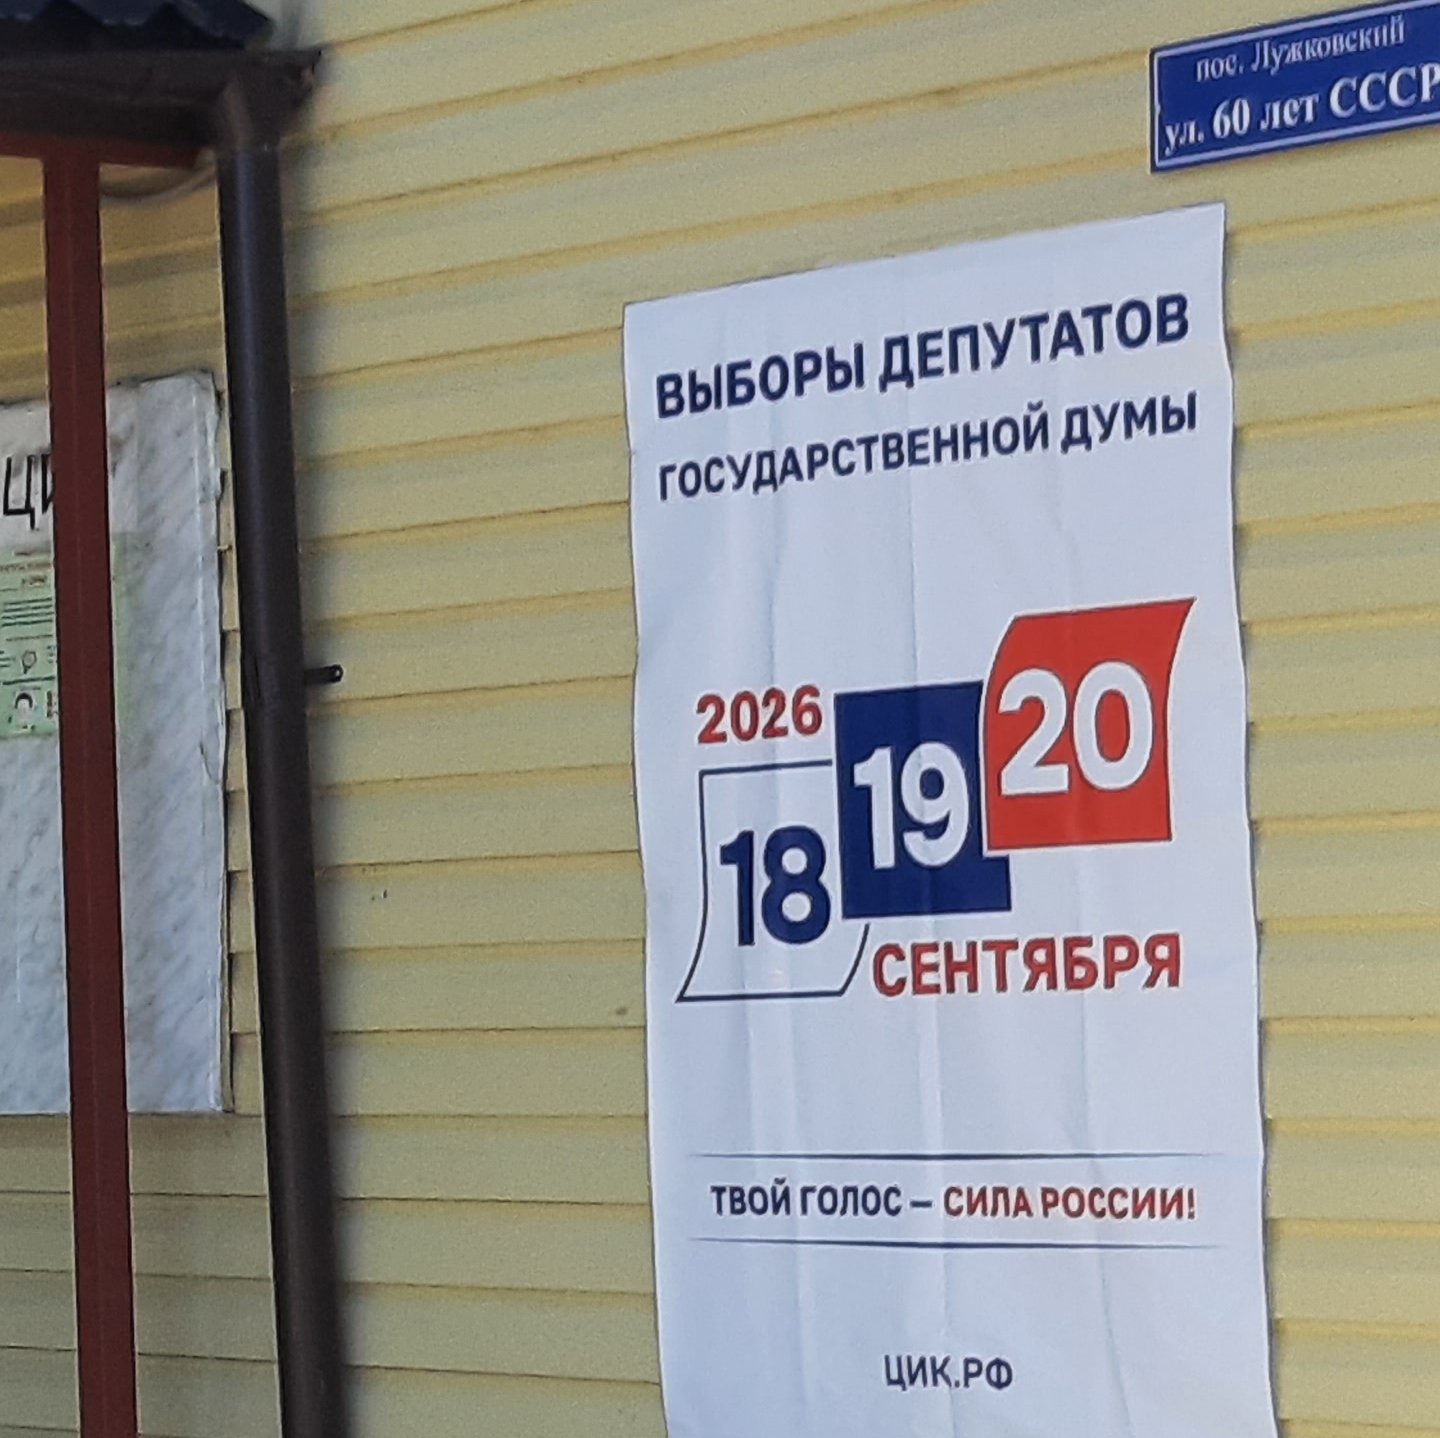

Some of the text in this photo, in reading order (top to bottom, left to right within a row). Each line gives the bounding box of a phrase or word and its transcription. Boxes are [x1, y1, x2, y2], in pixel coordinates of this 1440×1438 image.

[1196, 12, 1406, 83] пос. Лужковский
[1163, 119, 1205, 155] ул.
[1212, 96, 1251, 139] 60
[1259, 93, 1320, 133] лет
[655, 291, 1190, 419] ВЫБОРЫ ДЕПУТАТОВ
[658, 390, 1198, 501] ГОСУДАРСТВЕННОЙ ДУМЫ
[695, 684, 823, 744] 2026
[998, 660, 1154, 797] 20
[852, 740, 972, 870] 19
[719, 825, 832, 946] 18
[871, 932, 1182, 998] СЕНТЯБРЯ
[710, 1176, 792, 1218] ТВОЙ
[799, 1183, 904, 1218] ГОЛОС
[943, 1185, 1034, 1219] СИЛА
[1040, 1186, 1198, 1220] РОССИИ!
[883, 1353, 1015, 1392] ЦИК.РФ
